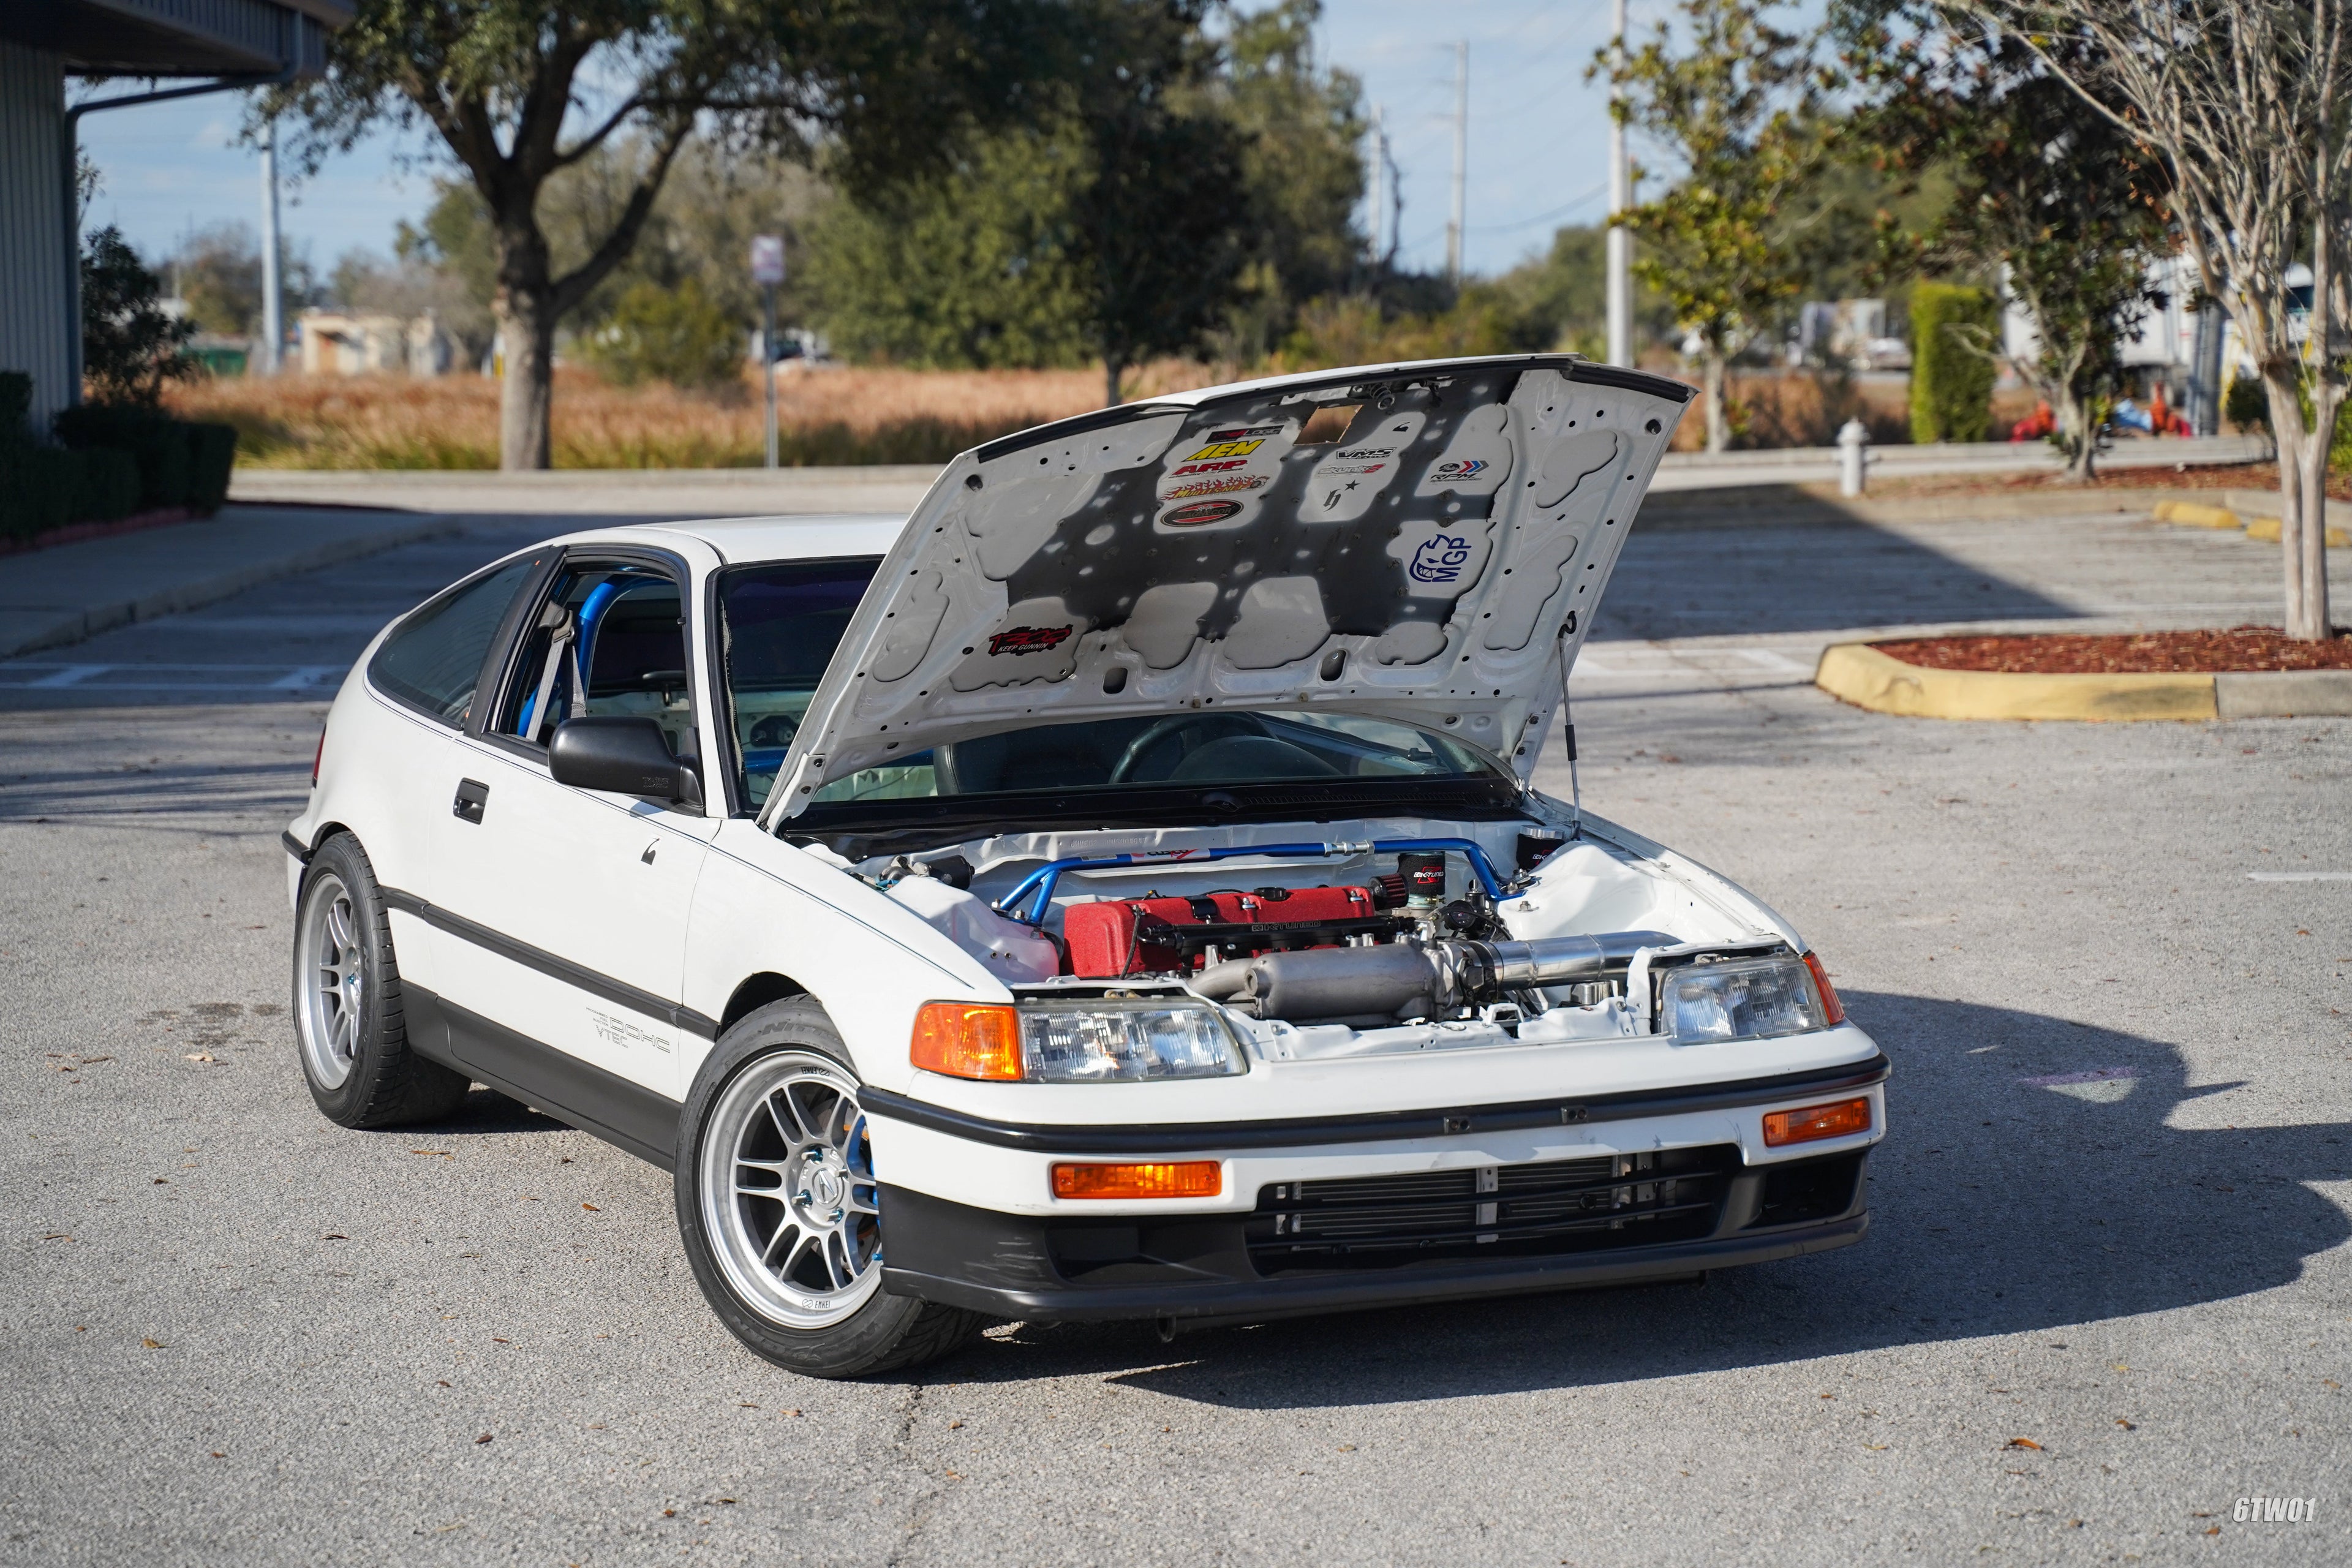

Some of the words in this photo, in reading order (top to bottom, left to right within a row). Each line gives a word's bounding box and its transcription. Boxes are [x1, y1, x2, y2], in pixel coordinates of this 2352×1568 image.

[1182, 439, 1266, 462] AEM
[1337, 447, 1396, 459] VMS
[1171, 459, 1247, 475] ARP
[1432, 537, 1472, 582] MGP
[596, 1025, 628, 1048] VTEC
[609, 1017, 670, 1054] DOHC
[815, 1300, 831, 1309] ENKEI
